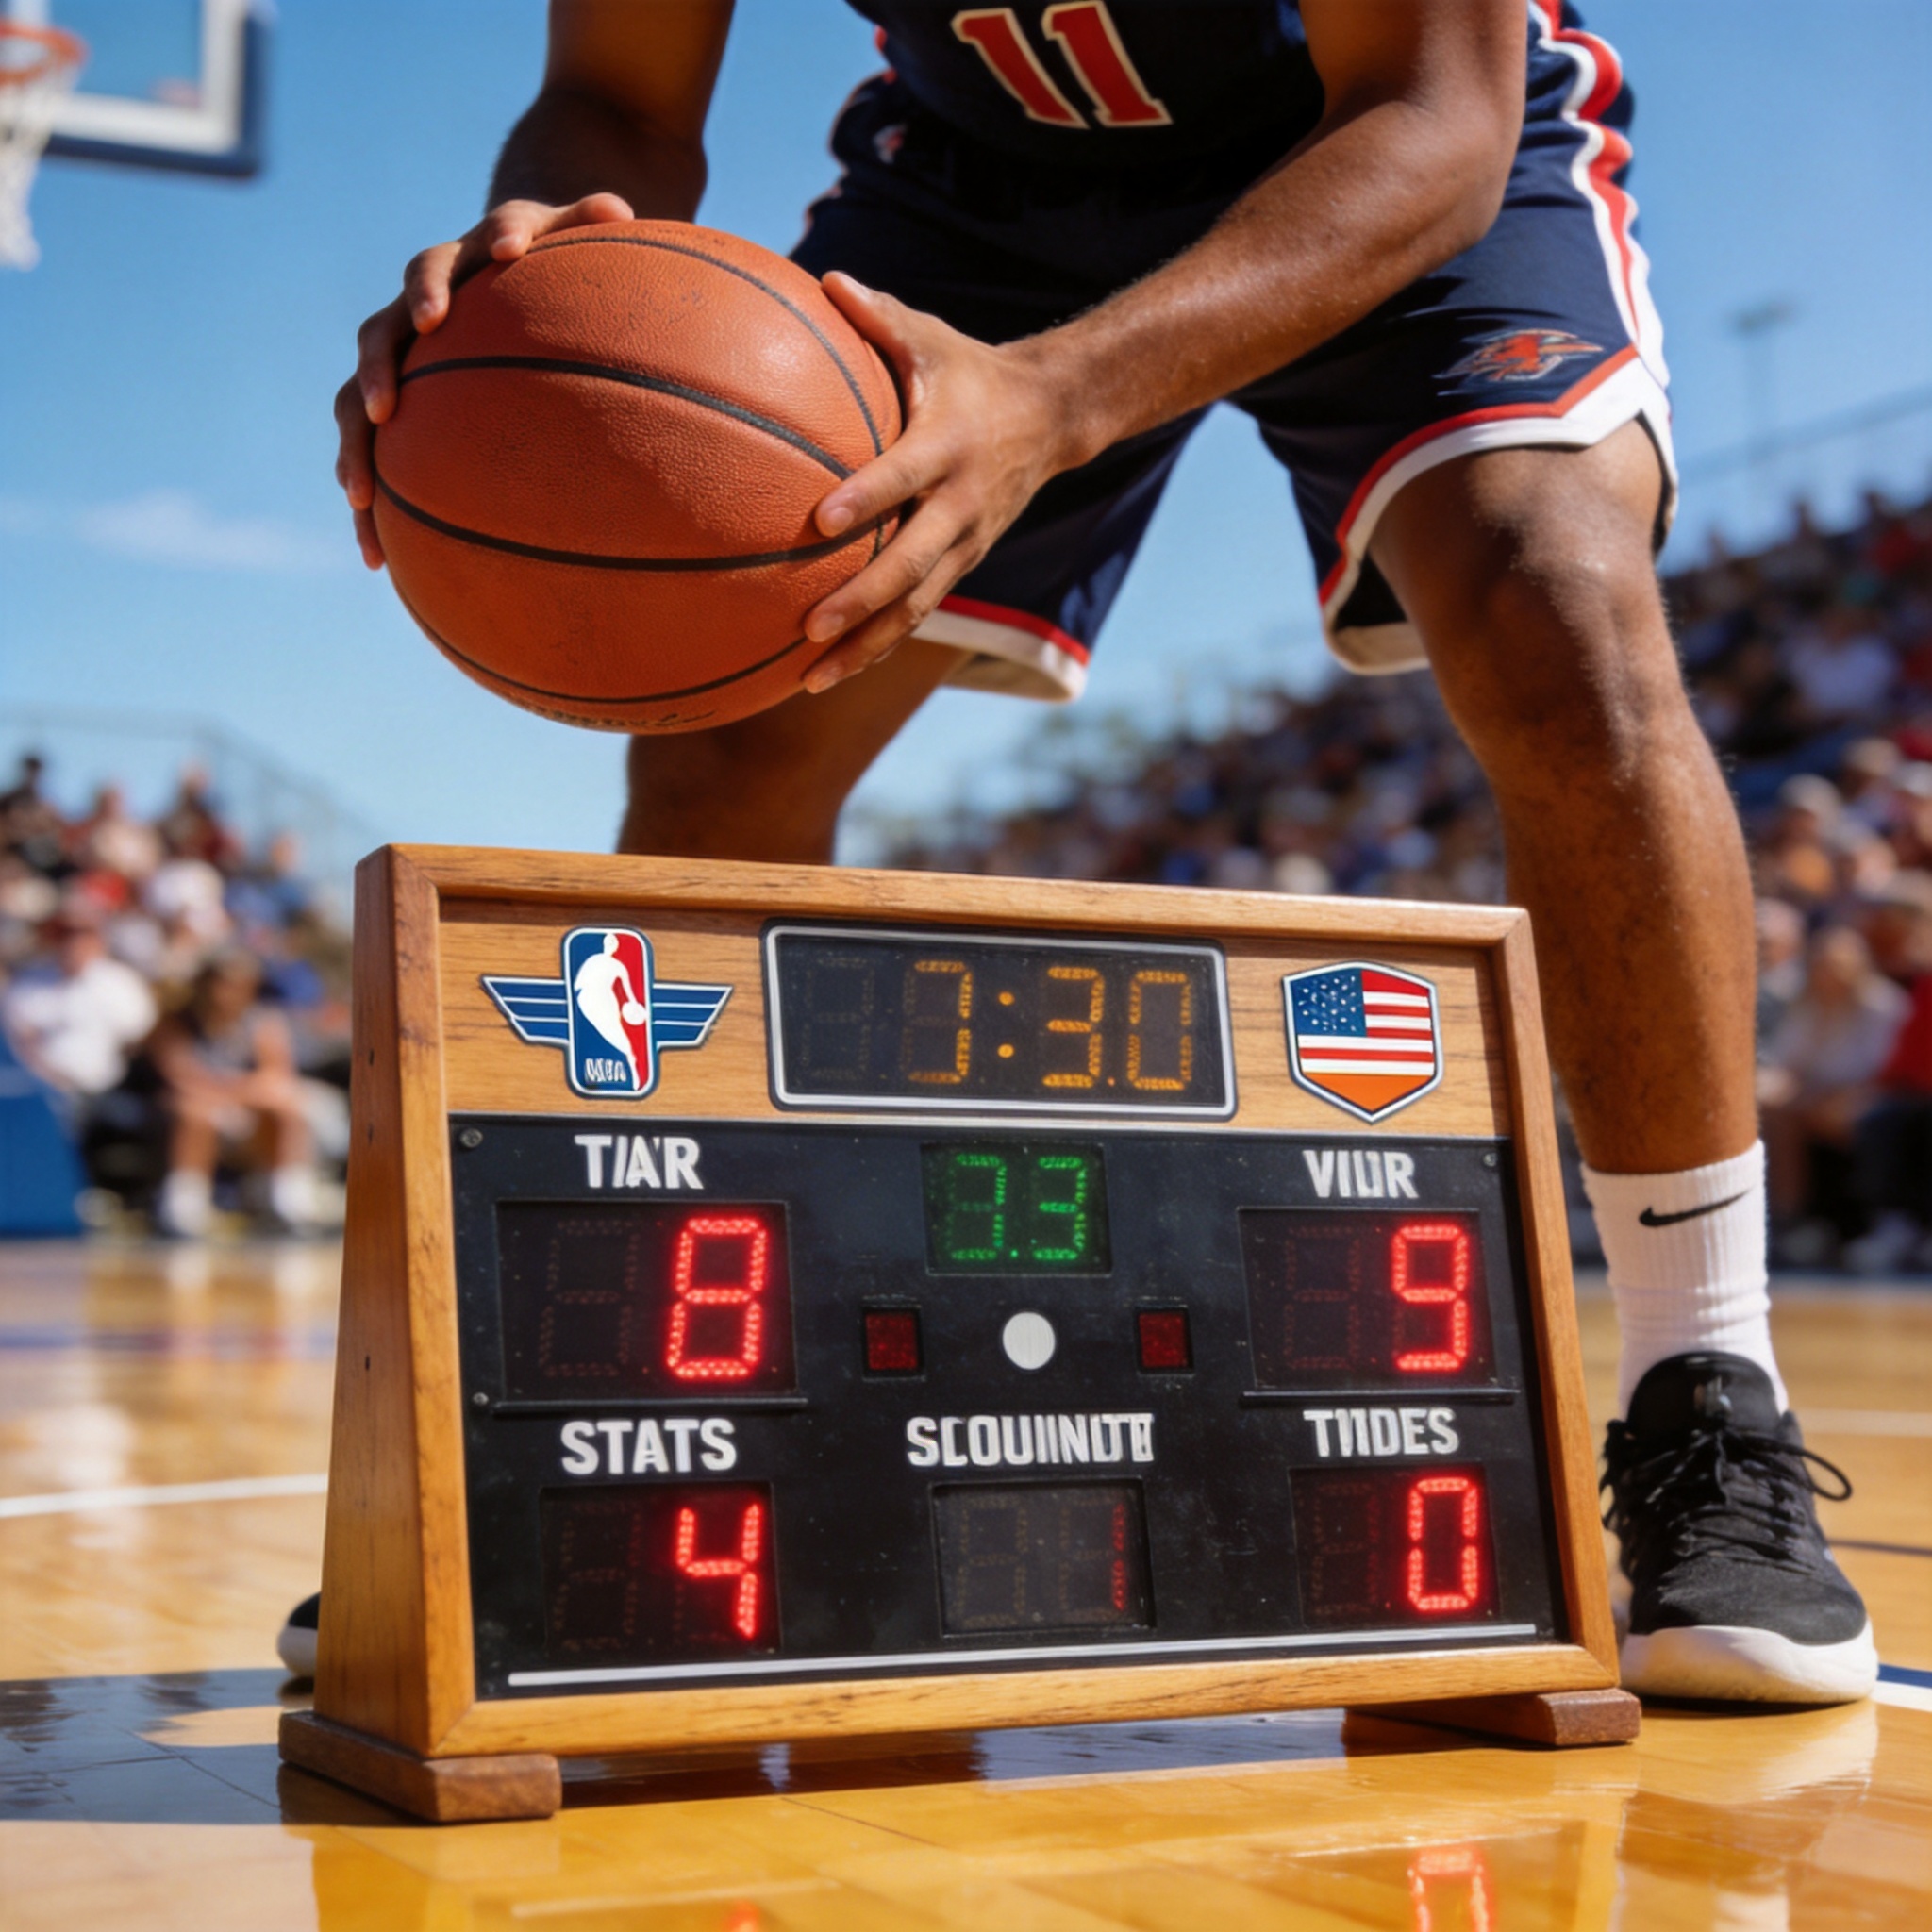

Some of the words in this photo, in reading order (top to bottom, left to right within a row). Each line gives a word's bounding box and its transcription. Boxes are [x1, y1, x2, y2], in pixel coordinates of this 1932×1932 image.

[951, 0, 1173, 129] 11
[666, 1216, 769, 1381] 8
[1391, 1221, 1472, 1374] 9
[560, 1417, 738, 1475] STATS
[675, 1503, 764, 1640] 4
[1406, 1475, 1481, 1614] 0
